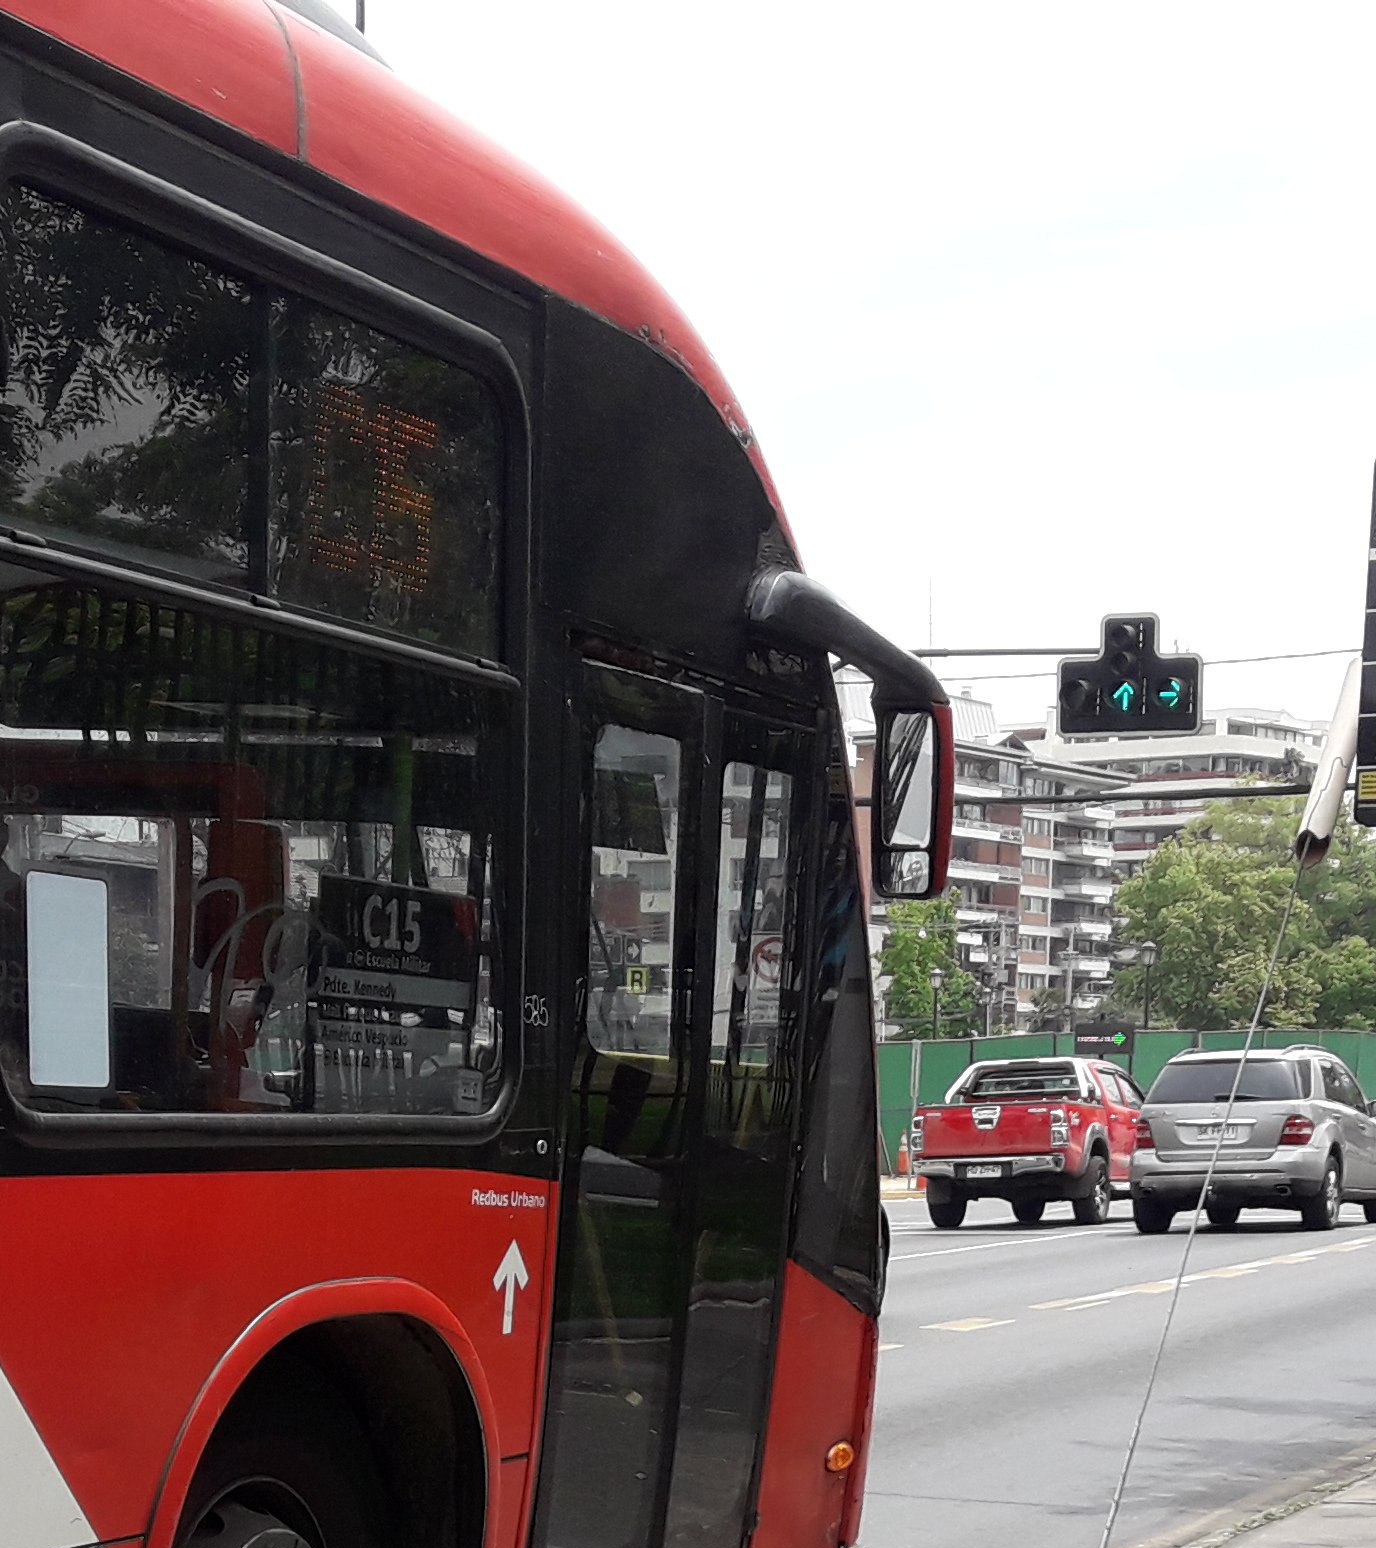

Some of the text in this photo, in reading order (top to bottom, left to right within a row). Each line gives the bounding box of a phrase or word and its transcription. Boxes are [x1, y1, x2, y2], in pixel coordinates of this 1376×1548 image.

[363, 894, 422, 953] C15
[366, 951, 400, 969] Escuela
[354, 980, 397, 1000] Kennedy
[471, 1189, 545, 1208] Redbus Urbano
